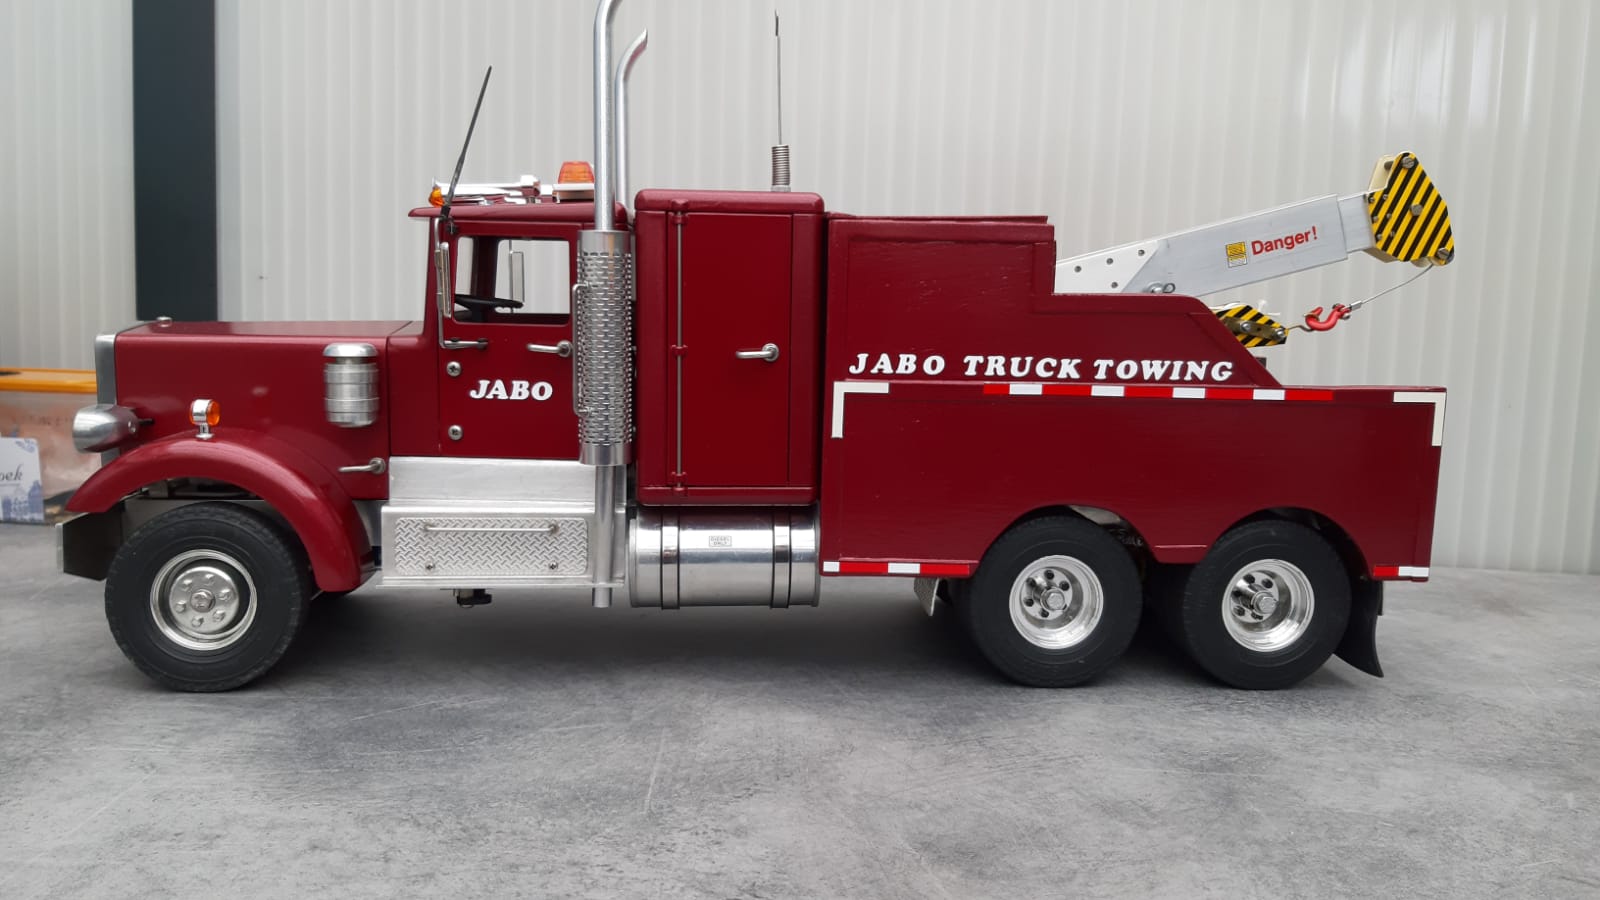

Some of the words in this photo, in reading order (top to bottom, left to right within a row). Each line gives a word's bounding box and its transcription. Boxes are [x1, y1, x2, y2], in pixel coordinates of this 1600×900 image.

[1251, 225, 1317, 255] Danger!
[849, 353, 946, 376] JABO
[964, 355, 1082, 379] TRUCK
[1094, 359, 1233, 382] TOWING
[469, 379, 553, 401] JABO
